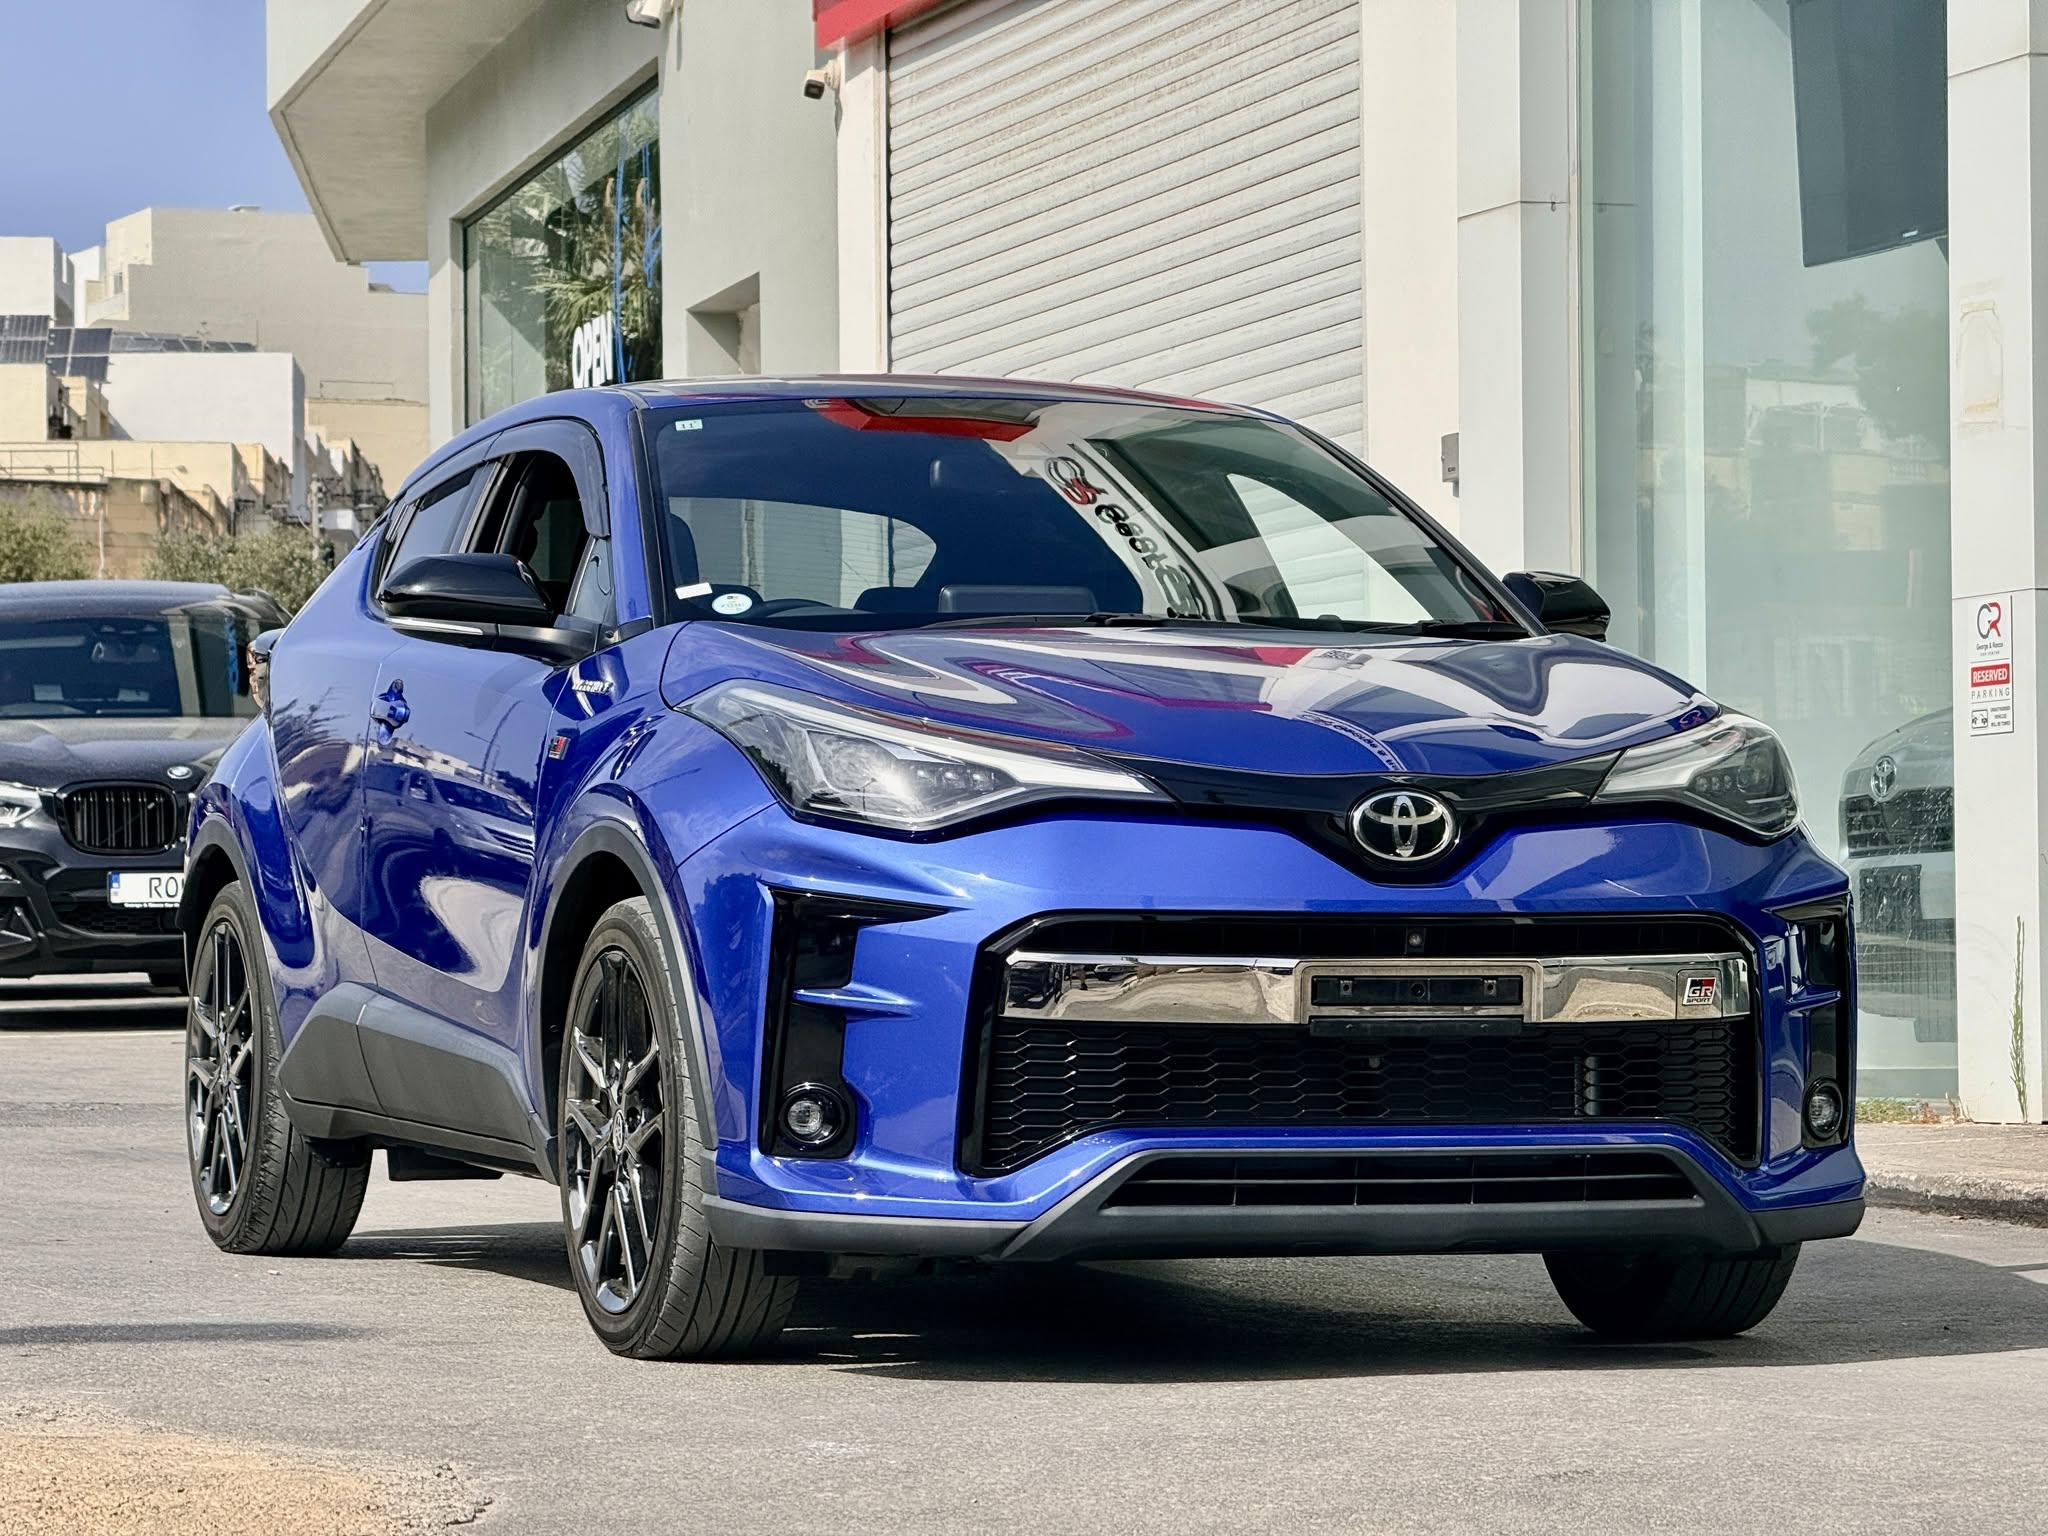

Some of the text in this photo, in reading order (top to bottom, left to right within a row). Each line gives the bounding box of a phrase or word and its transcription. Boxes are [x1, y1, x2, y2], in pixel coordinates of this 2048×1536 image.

[572, 310, 613, 389] OPEN
[1973, 668, 2008, 683] RESERVED
[1971, 687, 2010, 700] PARKING
[149, 876, 184, 898] RO
[1688, 986, 1713, 997] GR
